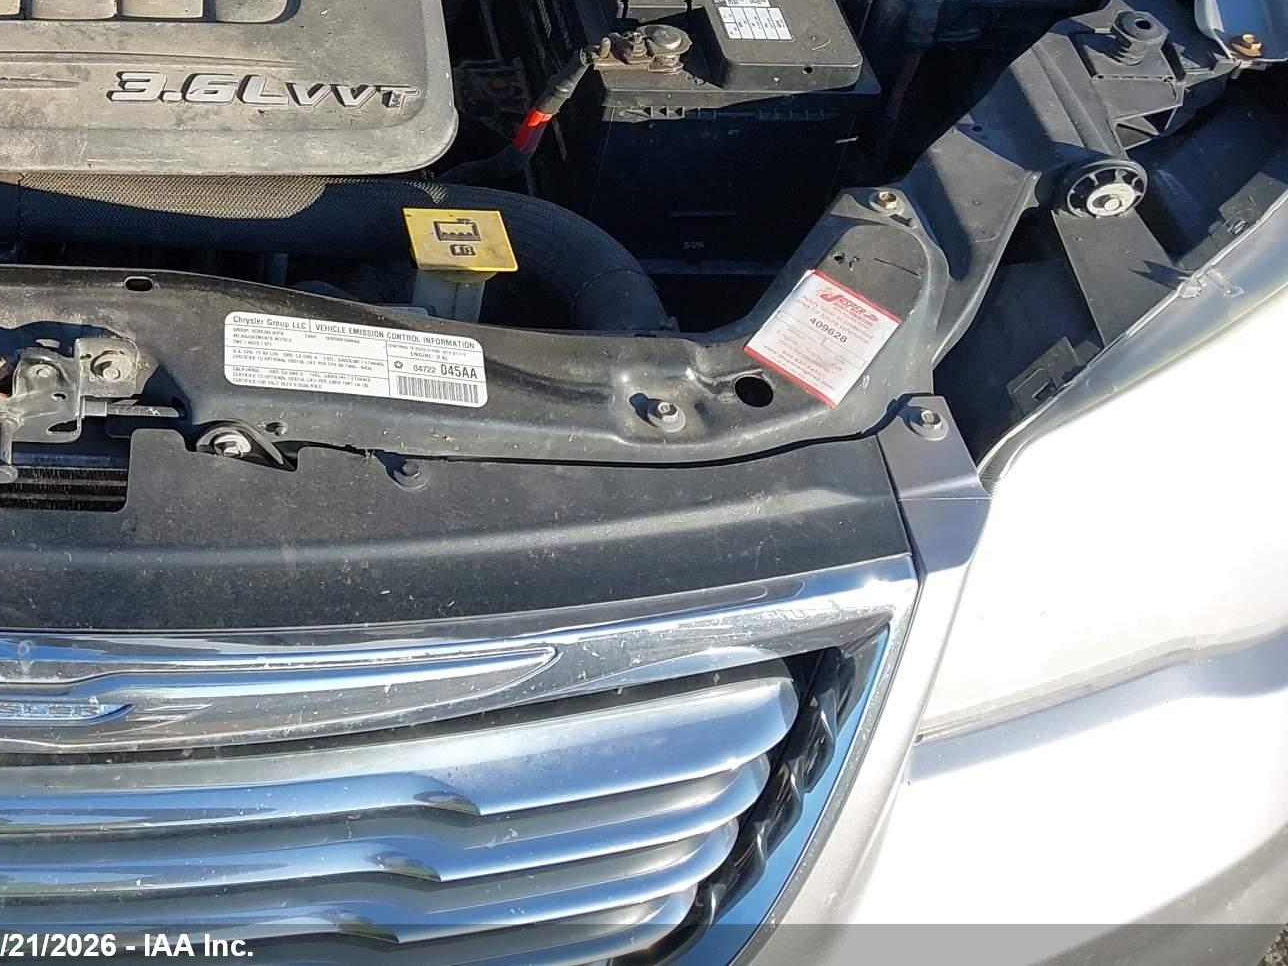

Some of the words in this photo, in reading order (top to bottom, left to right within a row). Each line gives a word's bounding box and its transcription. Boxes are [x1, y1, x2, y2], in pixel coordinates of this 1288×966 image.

[233, 315, 263, 328] Chrysler
[267, 318, 290, 331] Group
[292, 320, 307, 331] LLC
[315, 324, 346, 335] VEHICLE
[348, 326, 384, 339] EMISSION
[387, 330, 420, 344] CONTROL
[423, 334, 475, 350] INFORMATION
[809, 316, 848, 343] 409628
[413, 363, 437, 375] 04722
[440, 362, 478, 380] 045AA
